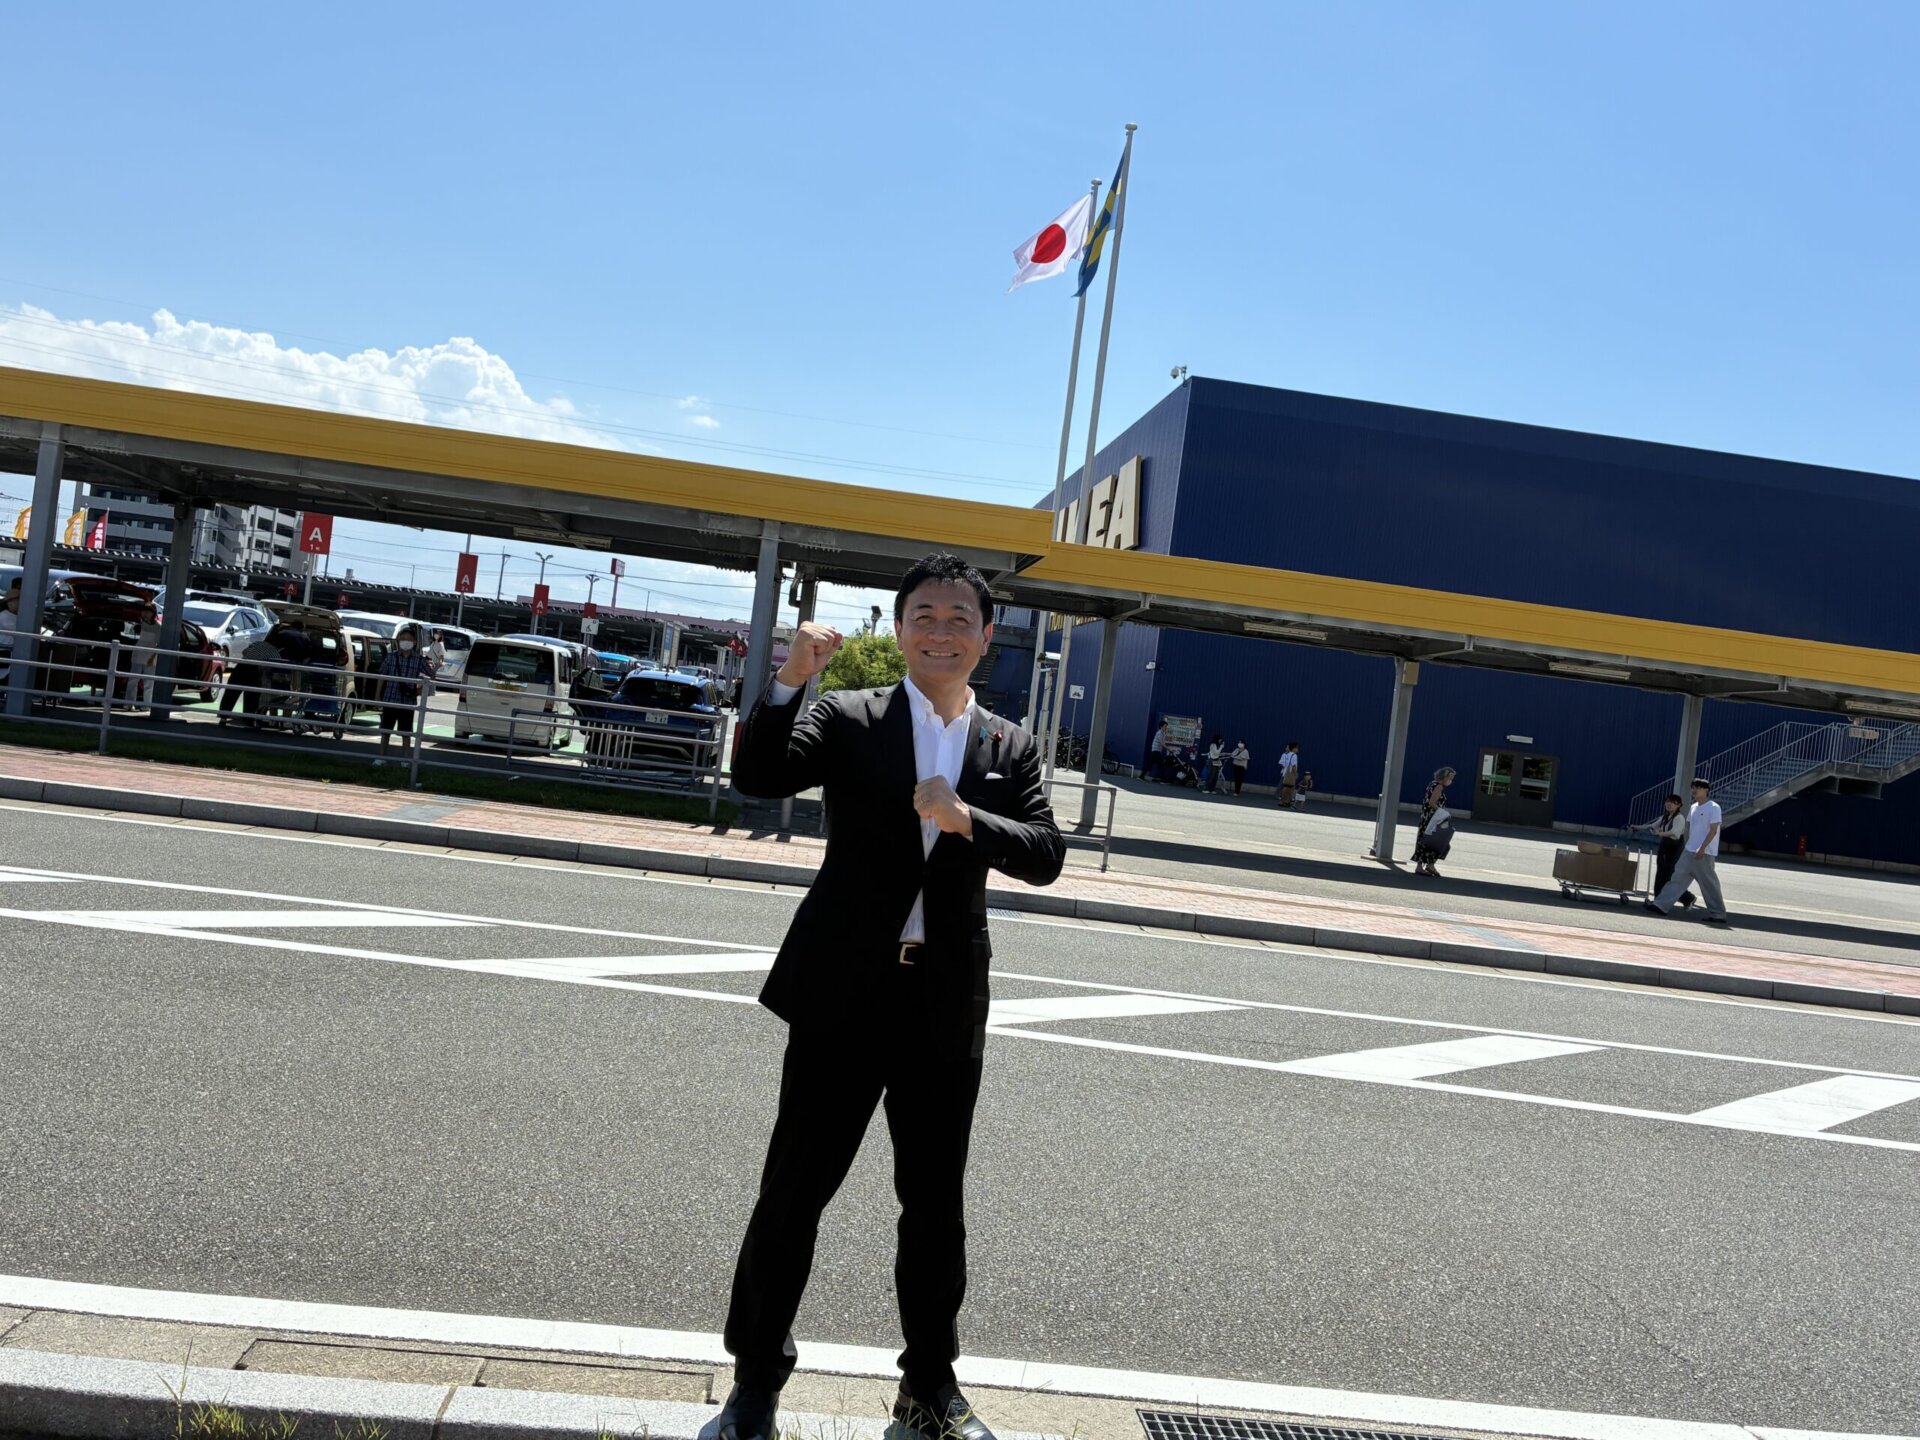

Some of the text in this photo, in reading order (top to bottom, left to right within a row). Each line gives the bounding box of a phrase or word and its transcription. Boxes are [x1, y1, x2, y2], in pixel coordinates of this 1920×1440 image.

[309, 527, 323, 543] A
[460, 574, 470, 586] A
[288, 583, 295, 591] A
[341, 595, 347, 603] A
[536, 600, 544, 609] A
